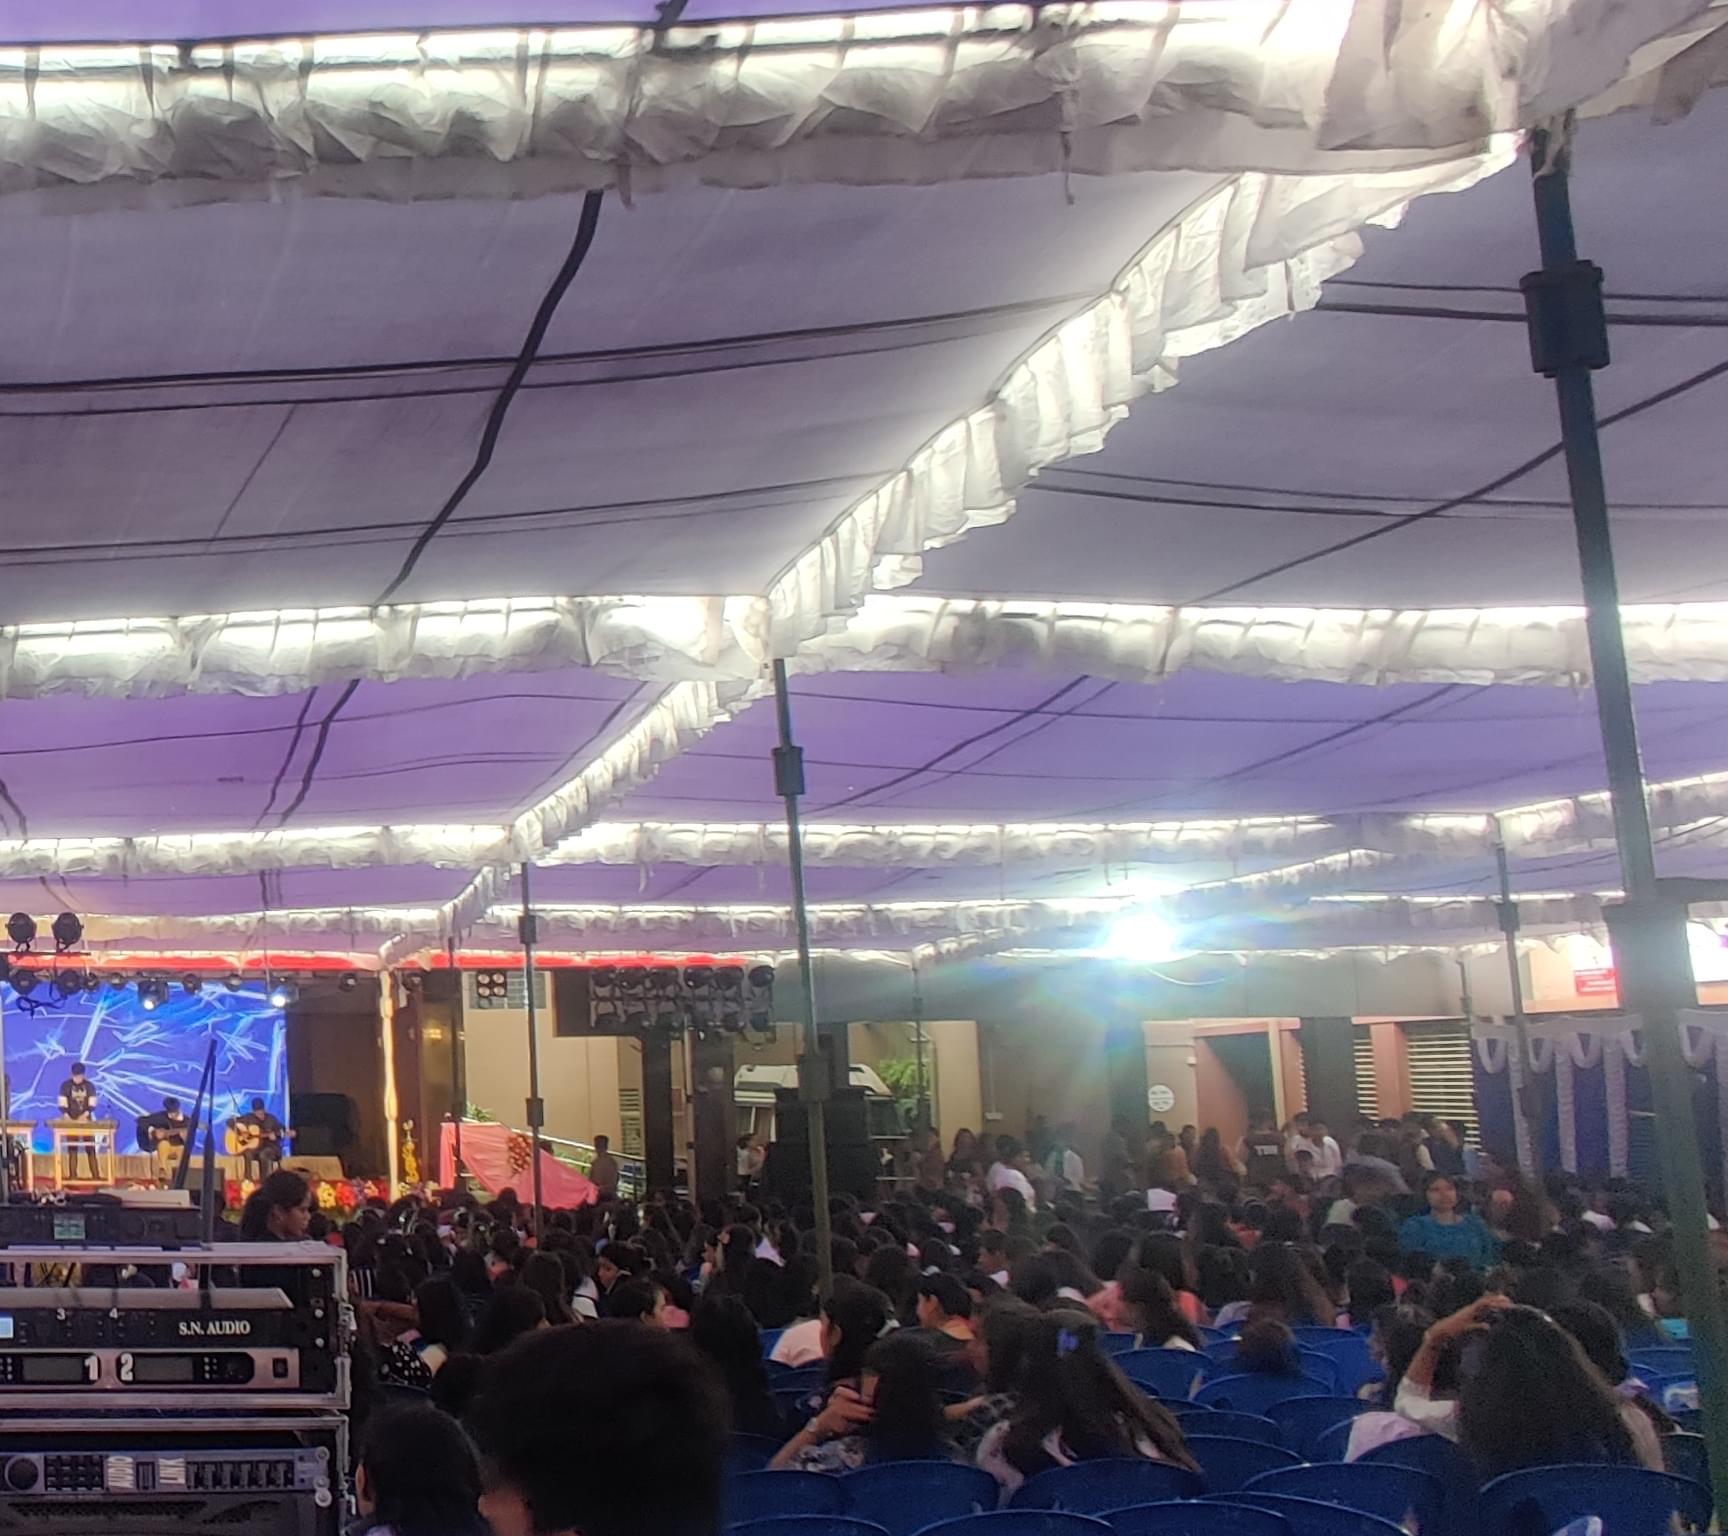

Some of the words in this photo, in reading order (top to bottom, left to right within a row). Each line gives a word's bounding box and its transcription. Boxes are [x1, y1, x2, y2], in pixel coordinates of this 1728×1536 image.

[56, 1308, 66, 1322] 3
[108, 1307, 119, 1320] 4
[207, 1319, 251, 1335] AUDIO
[84, 1355, 99, 1381] 1
[120, 1352, 134, 1382] 2
[107, 1455, 134, 1489] AUDIO
[158, 1457, 186, 1485] LINK
